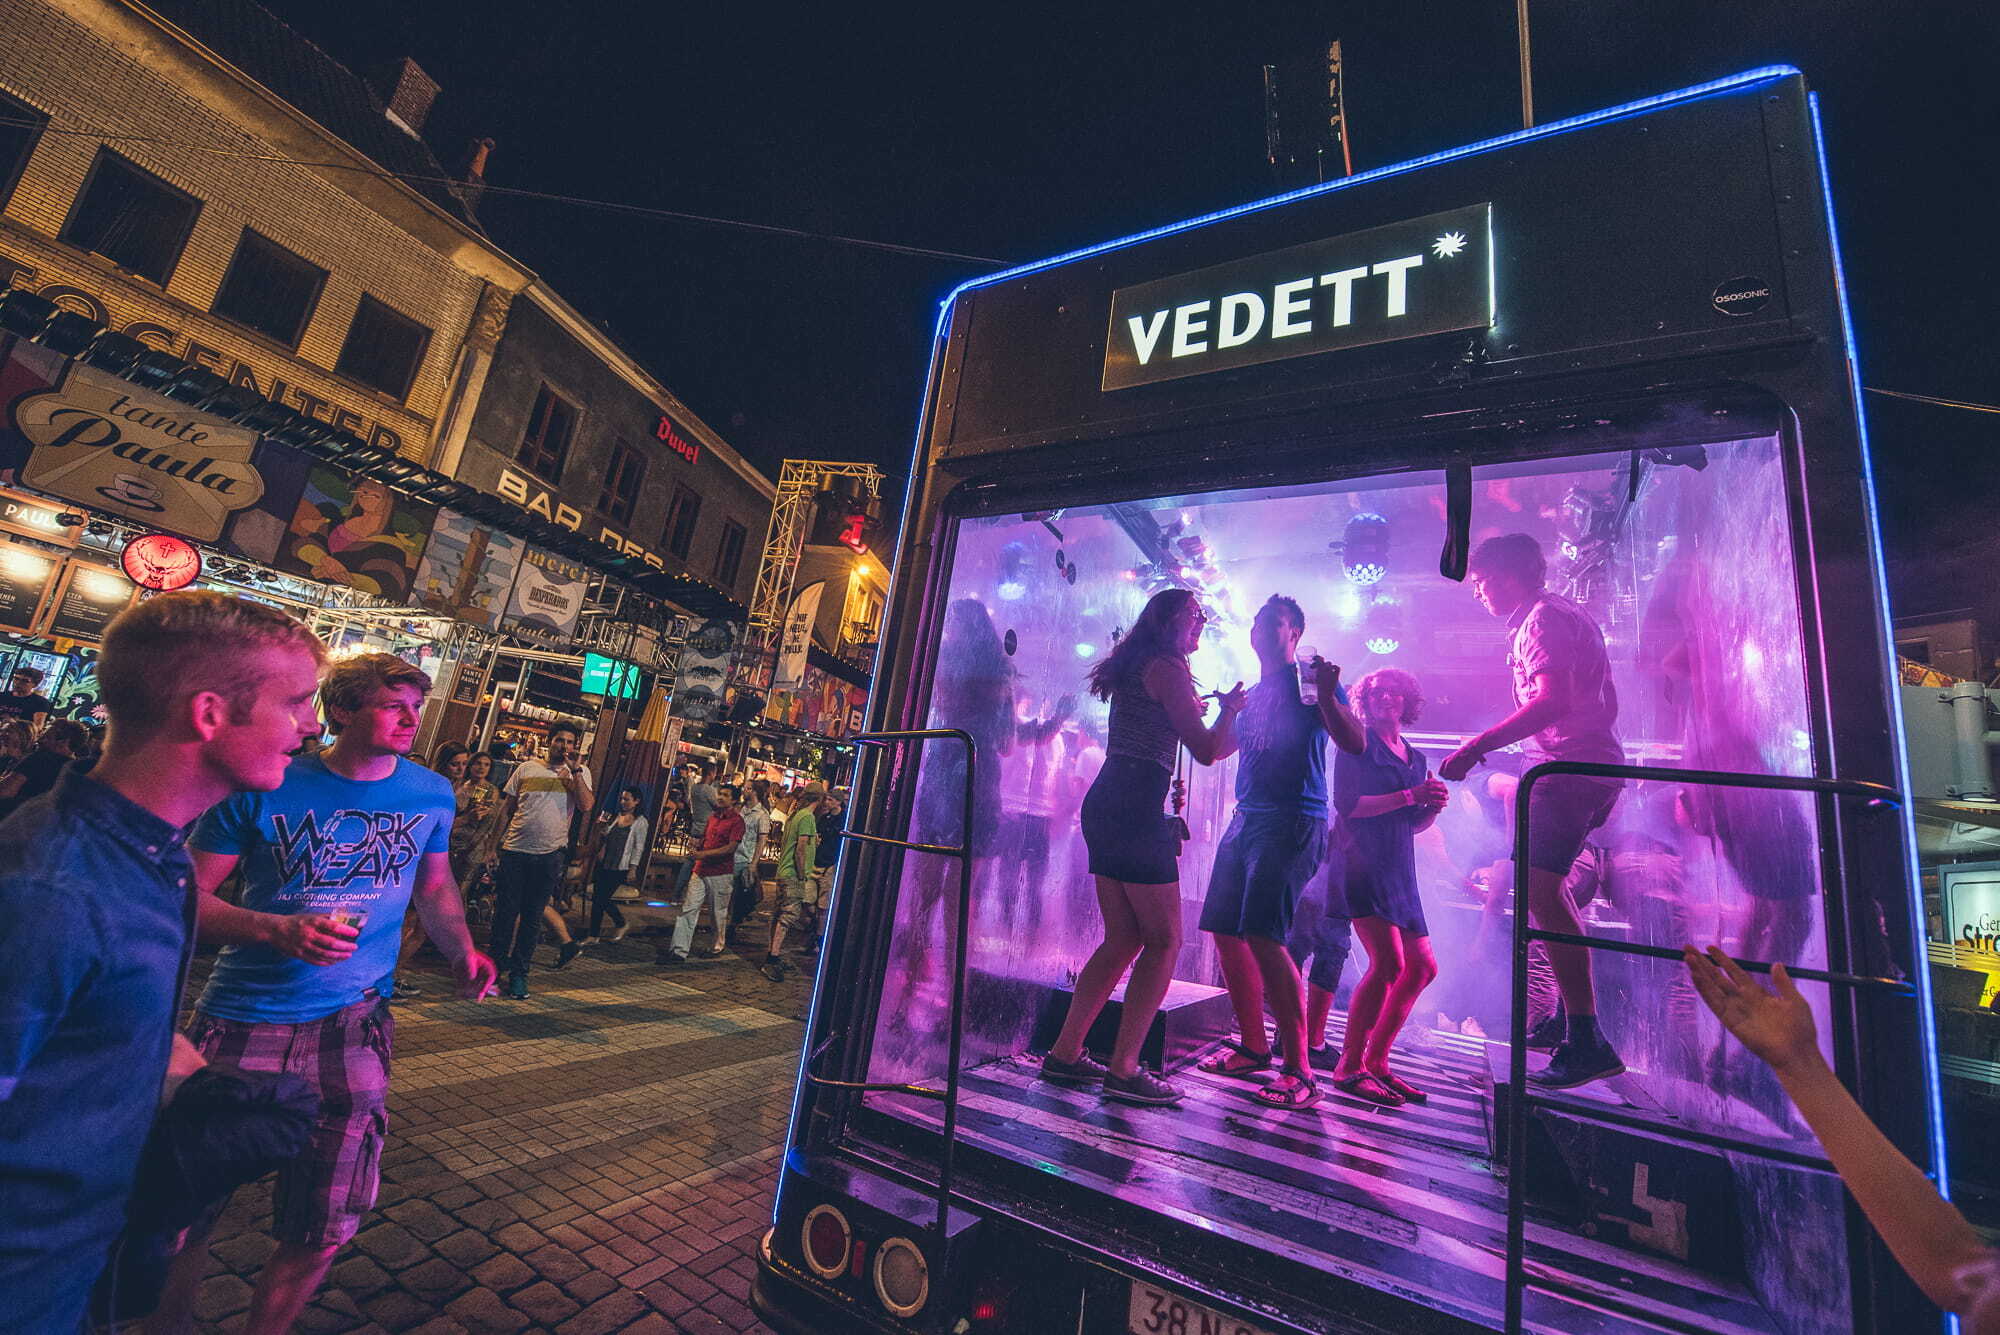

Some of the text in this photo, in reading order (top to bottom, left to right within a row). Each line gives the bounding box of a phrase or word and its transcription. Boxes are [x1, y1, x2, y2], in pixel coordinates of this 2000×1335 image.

[1128, 254, 1424, 366] VEDETT
[1715, 288, 1769, 304] OSOSONIC
[108, 396, 209, 447] tante
[656, 415, 701, 465] Duvel
[49, 408, 237, 495] Paula
[496, 468, 583, 533] BAR
[271, 809, 428, 860] WORK
[271, 843, 414, 891] WEAR
[339, 892, 383, 901] COMPANY
[1143, 1291, 1187, 1335] 38
